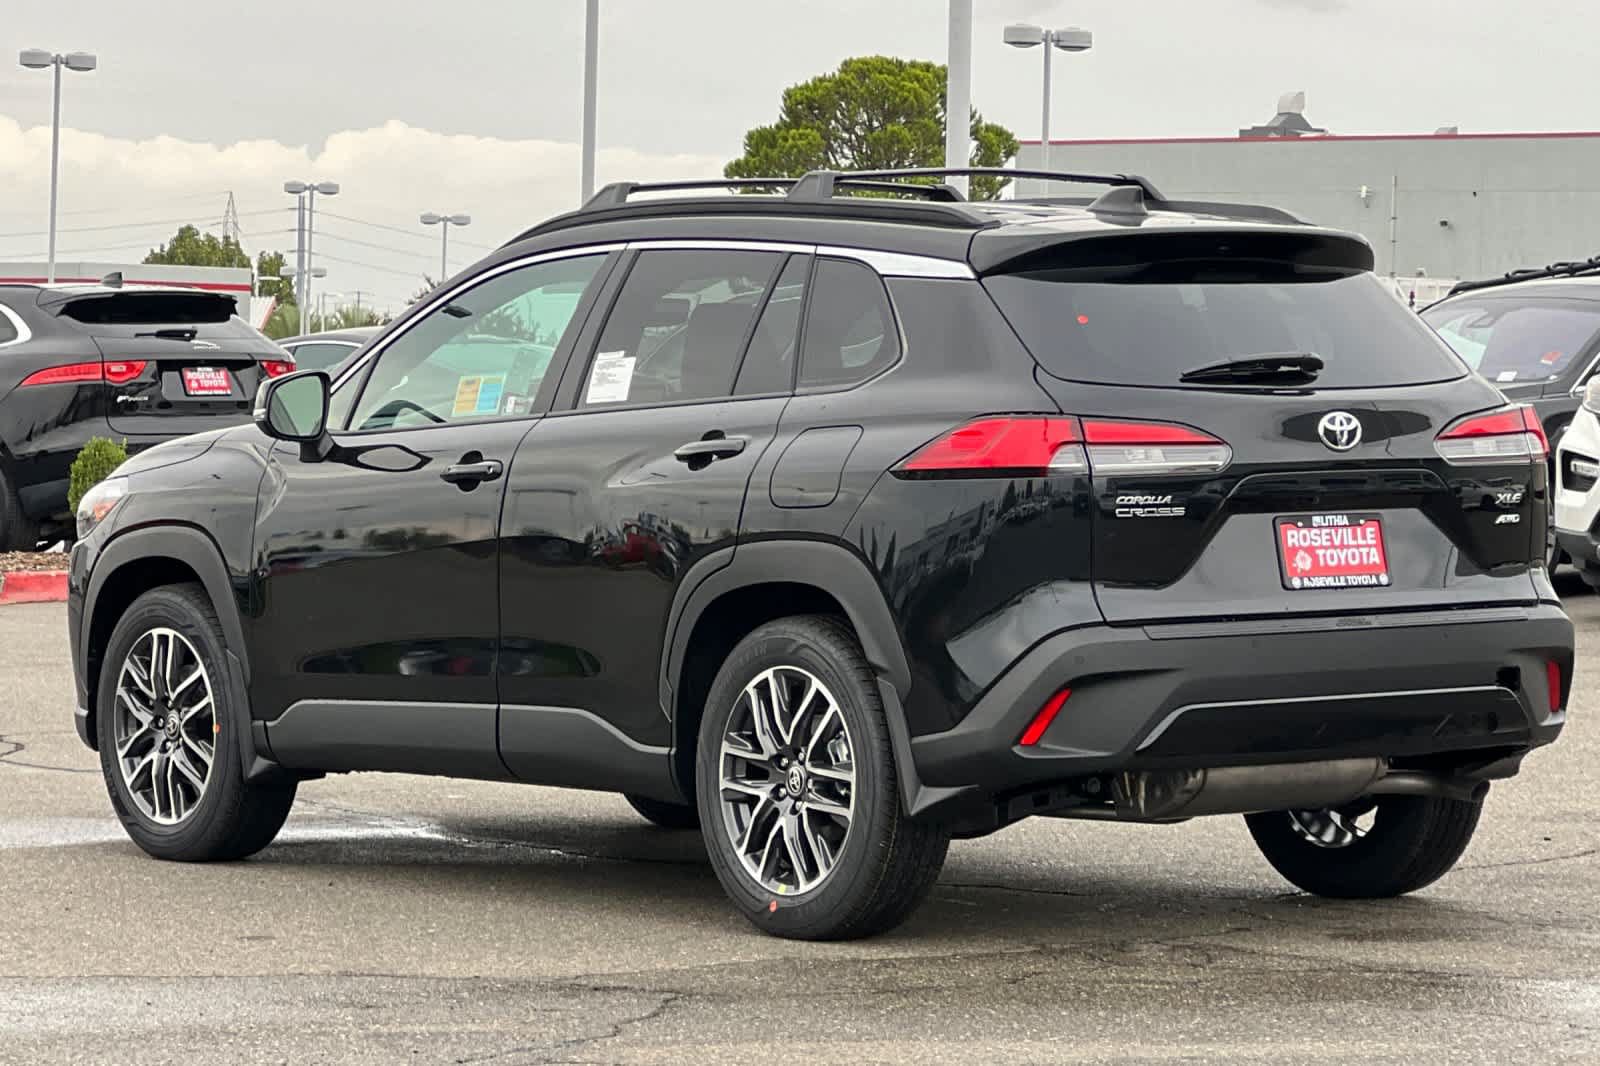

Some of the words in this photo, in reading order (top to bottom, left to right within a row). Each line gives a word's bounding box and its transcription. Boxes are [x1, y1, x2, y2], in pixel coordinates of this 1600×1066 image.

[1115, 495, 1172, 505] COROLLA
[1495, 492, 1522, 504] XLE
[1115, 507, 1186, 518] CROSS
[1321, 515, 1349, 526] LITHIA
[1287, 527, 1377, 547] ROSEVILLE
[1315, 547, 1380, 567] TOYOTA
[1303, 575, 1346, 587] ROSEVILLE
[1347, 574, 1378, 586] TOYOTA
